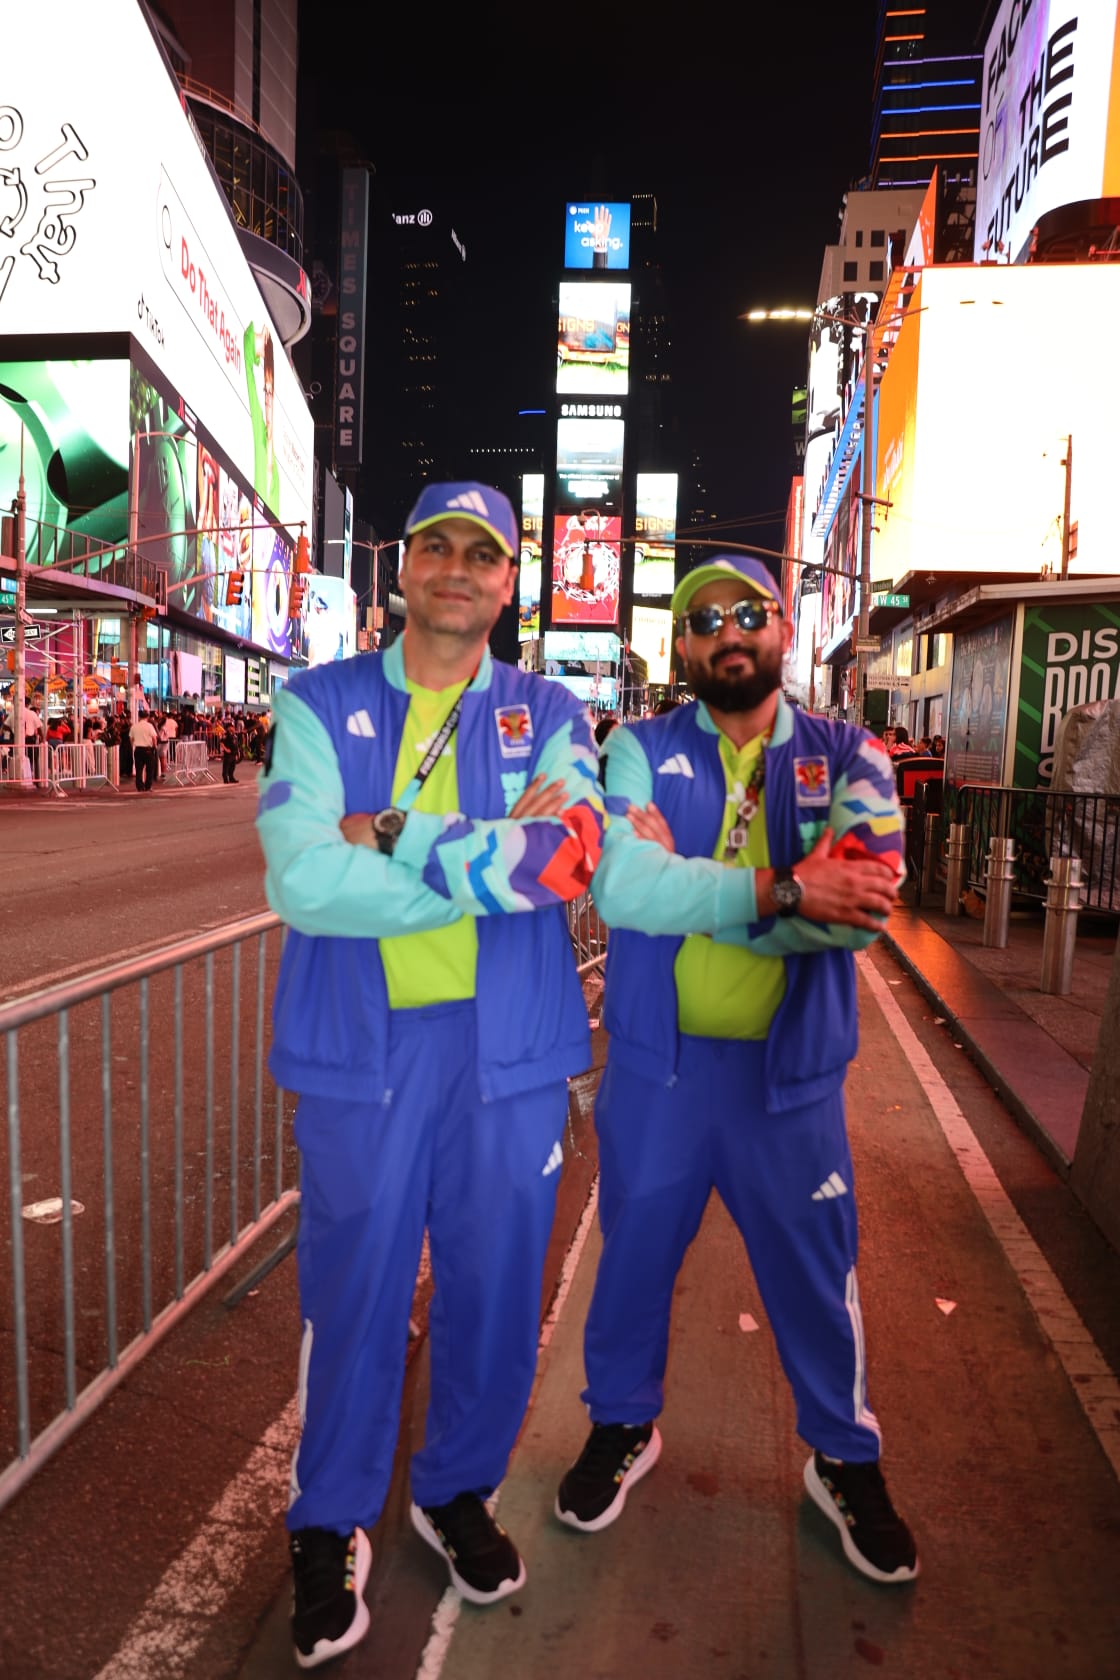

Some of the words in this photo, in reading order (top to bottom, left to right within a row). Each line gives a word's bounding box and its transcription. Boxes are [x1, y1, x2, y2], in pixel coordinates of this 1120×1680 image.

[1018, 17, 1078, 149] THE
[987, 92, 1073, 252] FUTURE
[341, 184, 360, 295] TIMES
[581, 236, 624, 250] asking.
[145, 305, 165, 350] TikTok
[181, 235, 197, 294] Do
[198, 266, 219, 335] That
[219, 311, 241, 375] Again
[338, 312, 357, 446] SQUARE
[561, 404, 622, 417] SAMSUNG
[635, 517, 674, 531] SIGNS
[879, 594, 887, 604] W
[891, 596, 900, 606] 45
